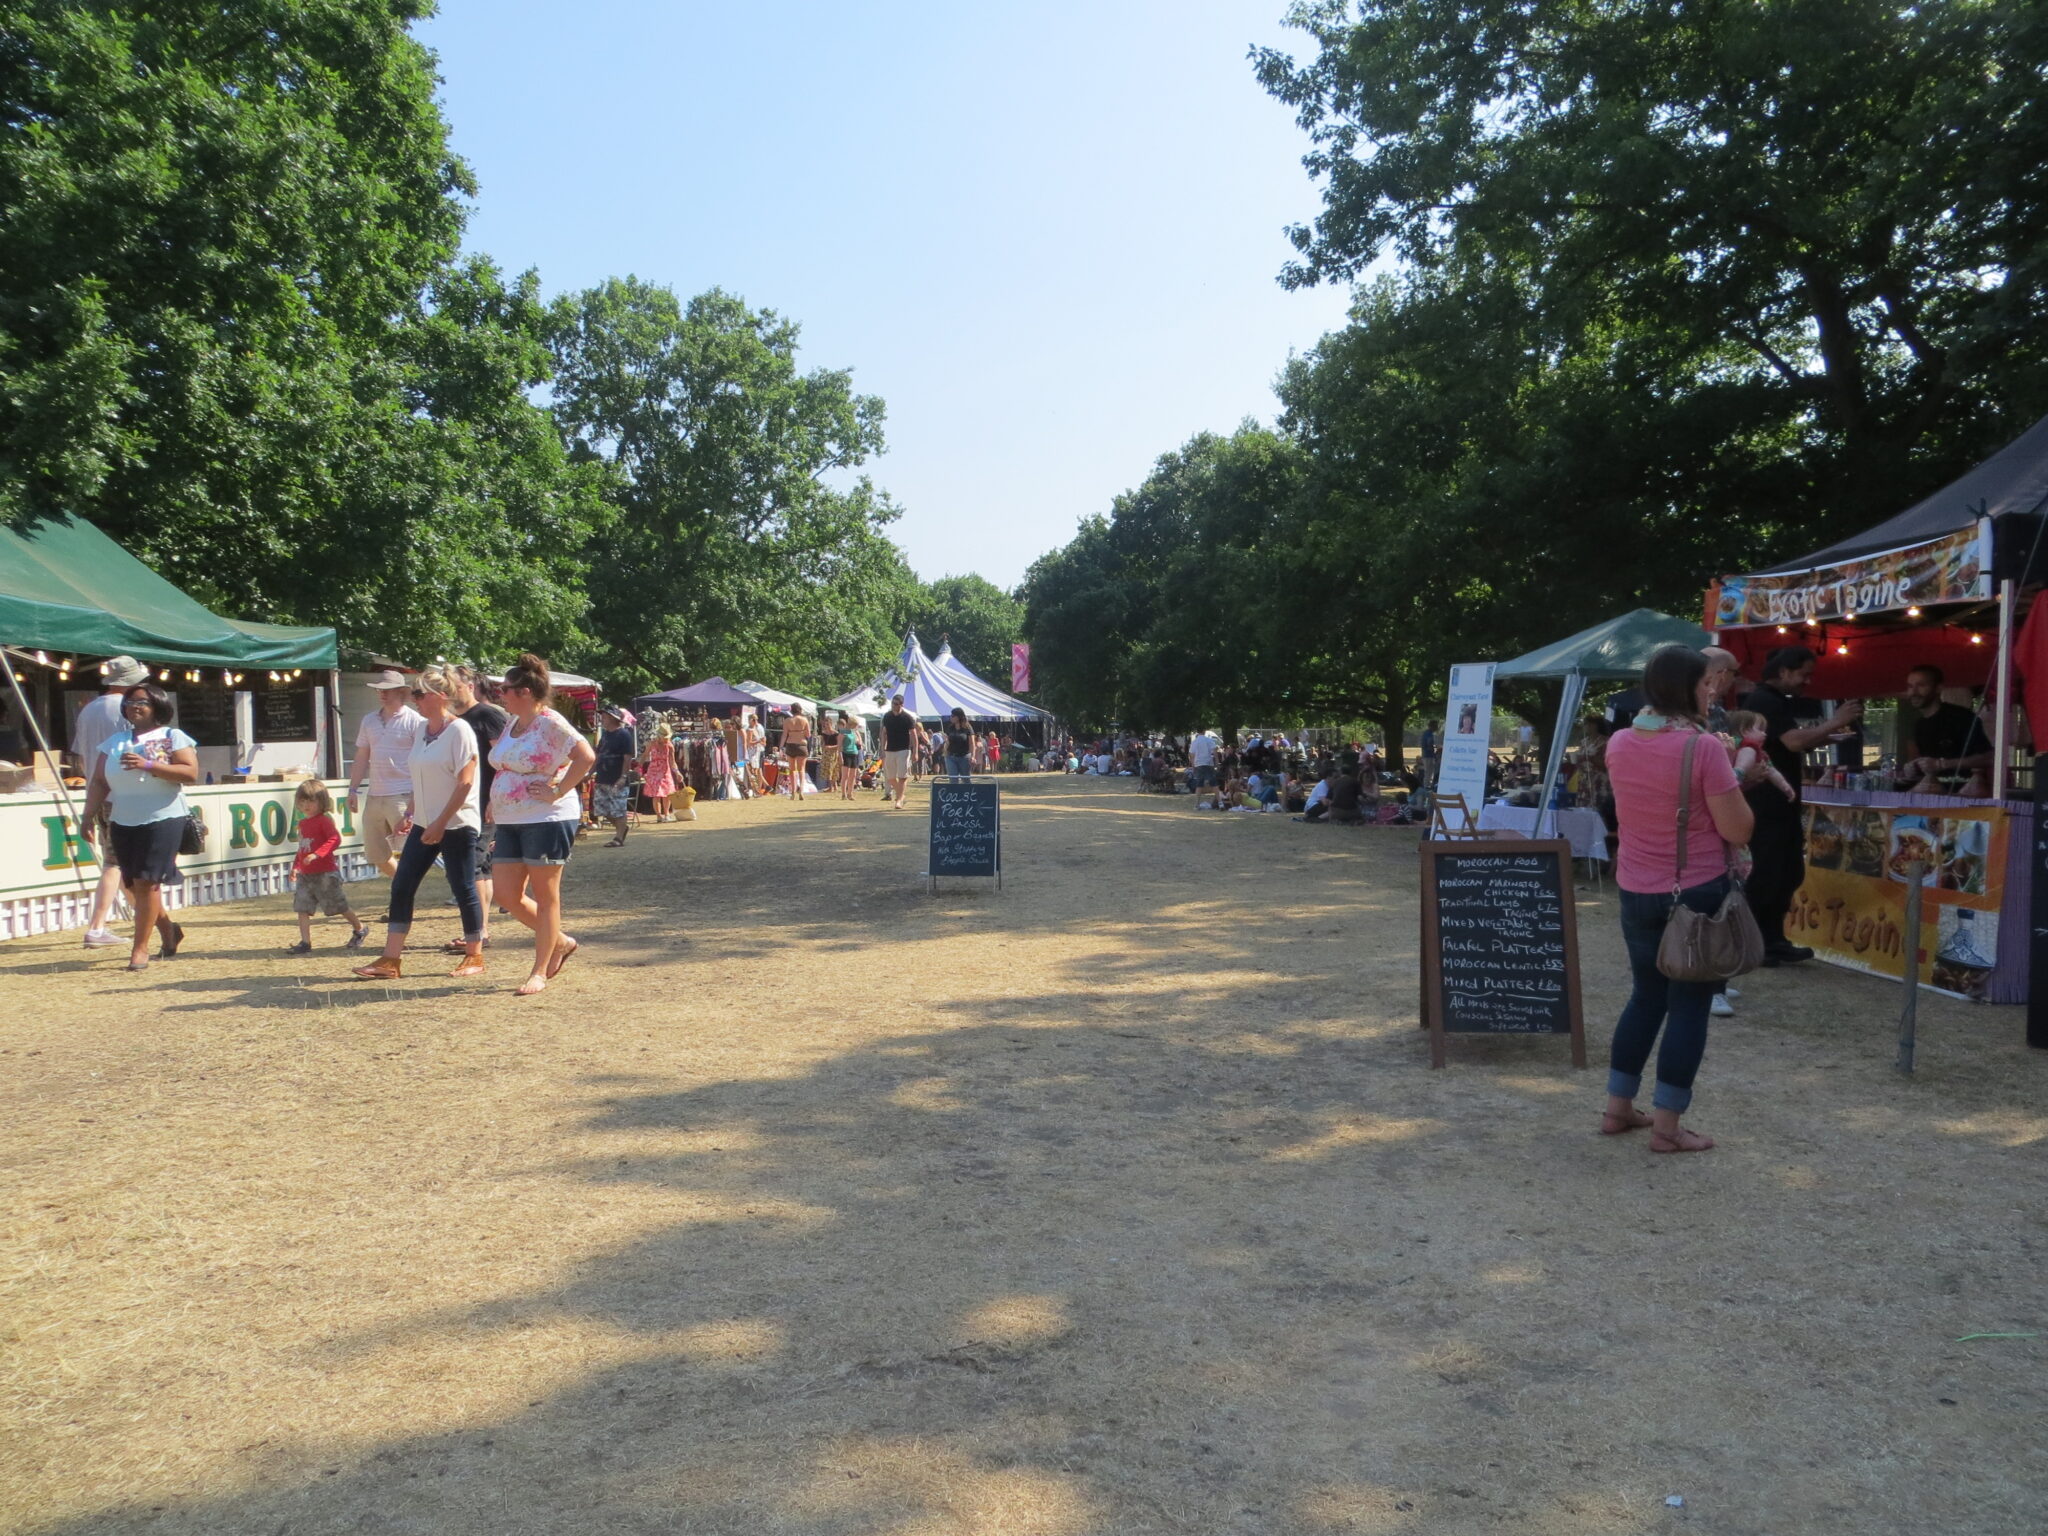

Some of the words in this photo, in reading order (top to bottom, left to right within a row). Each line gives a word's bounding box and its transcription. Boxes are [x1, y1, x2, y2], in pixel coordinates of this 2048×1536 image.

[1768, 584, 1826, 622] Exotic
[1830, 573, 1911, 614] Tagine
[938, 787, 978, 802] Roast
[1457, 857, 1509, 868] MOROCCAN
[1514, 857, 1539, 866] FOOD
[1439, 879, 1483, 889] MOROCCAN
[1488, 880, 1541, 889] MARINATED
[1484, 888, 1529, 898] CHICKEN
[1441, 916, 1475, 929] MIXED
[1825, 897, 1906, 960] Tagin
[1491, 939, 1547, 955] PLATTER
[1443, 958, 1501, 969] MOROCCAN
[1484, 976, 1536, 991] PLATTER
